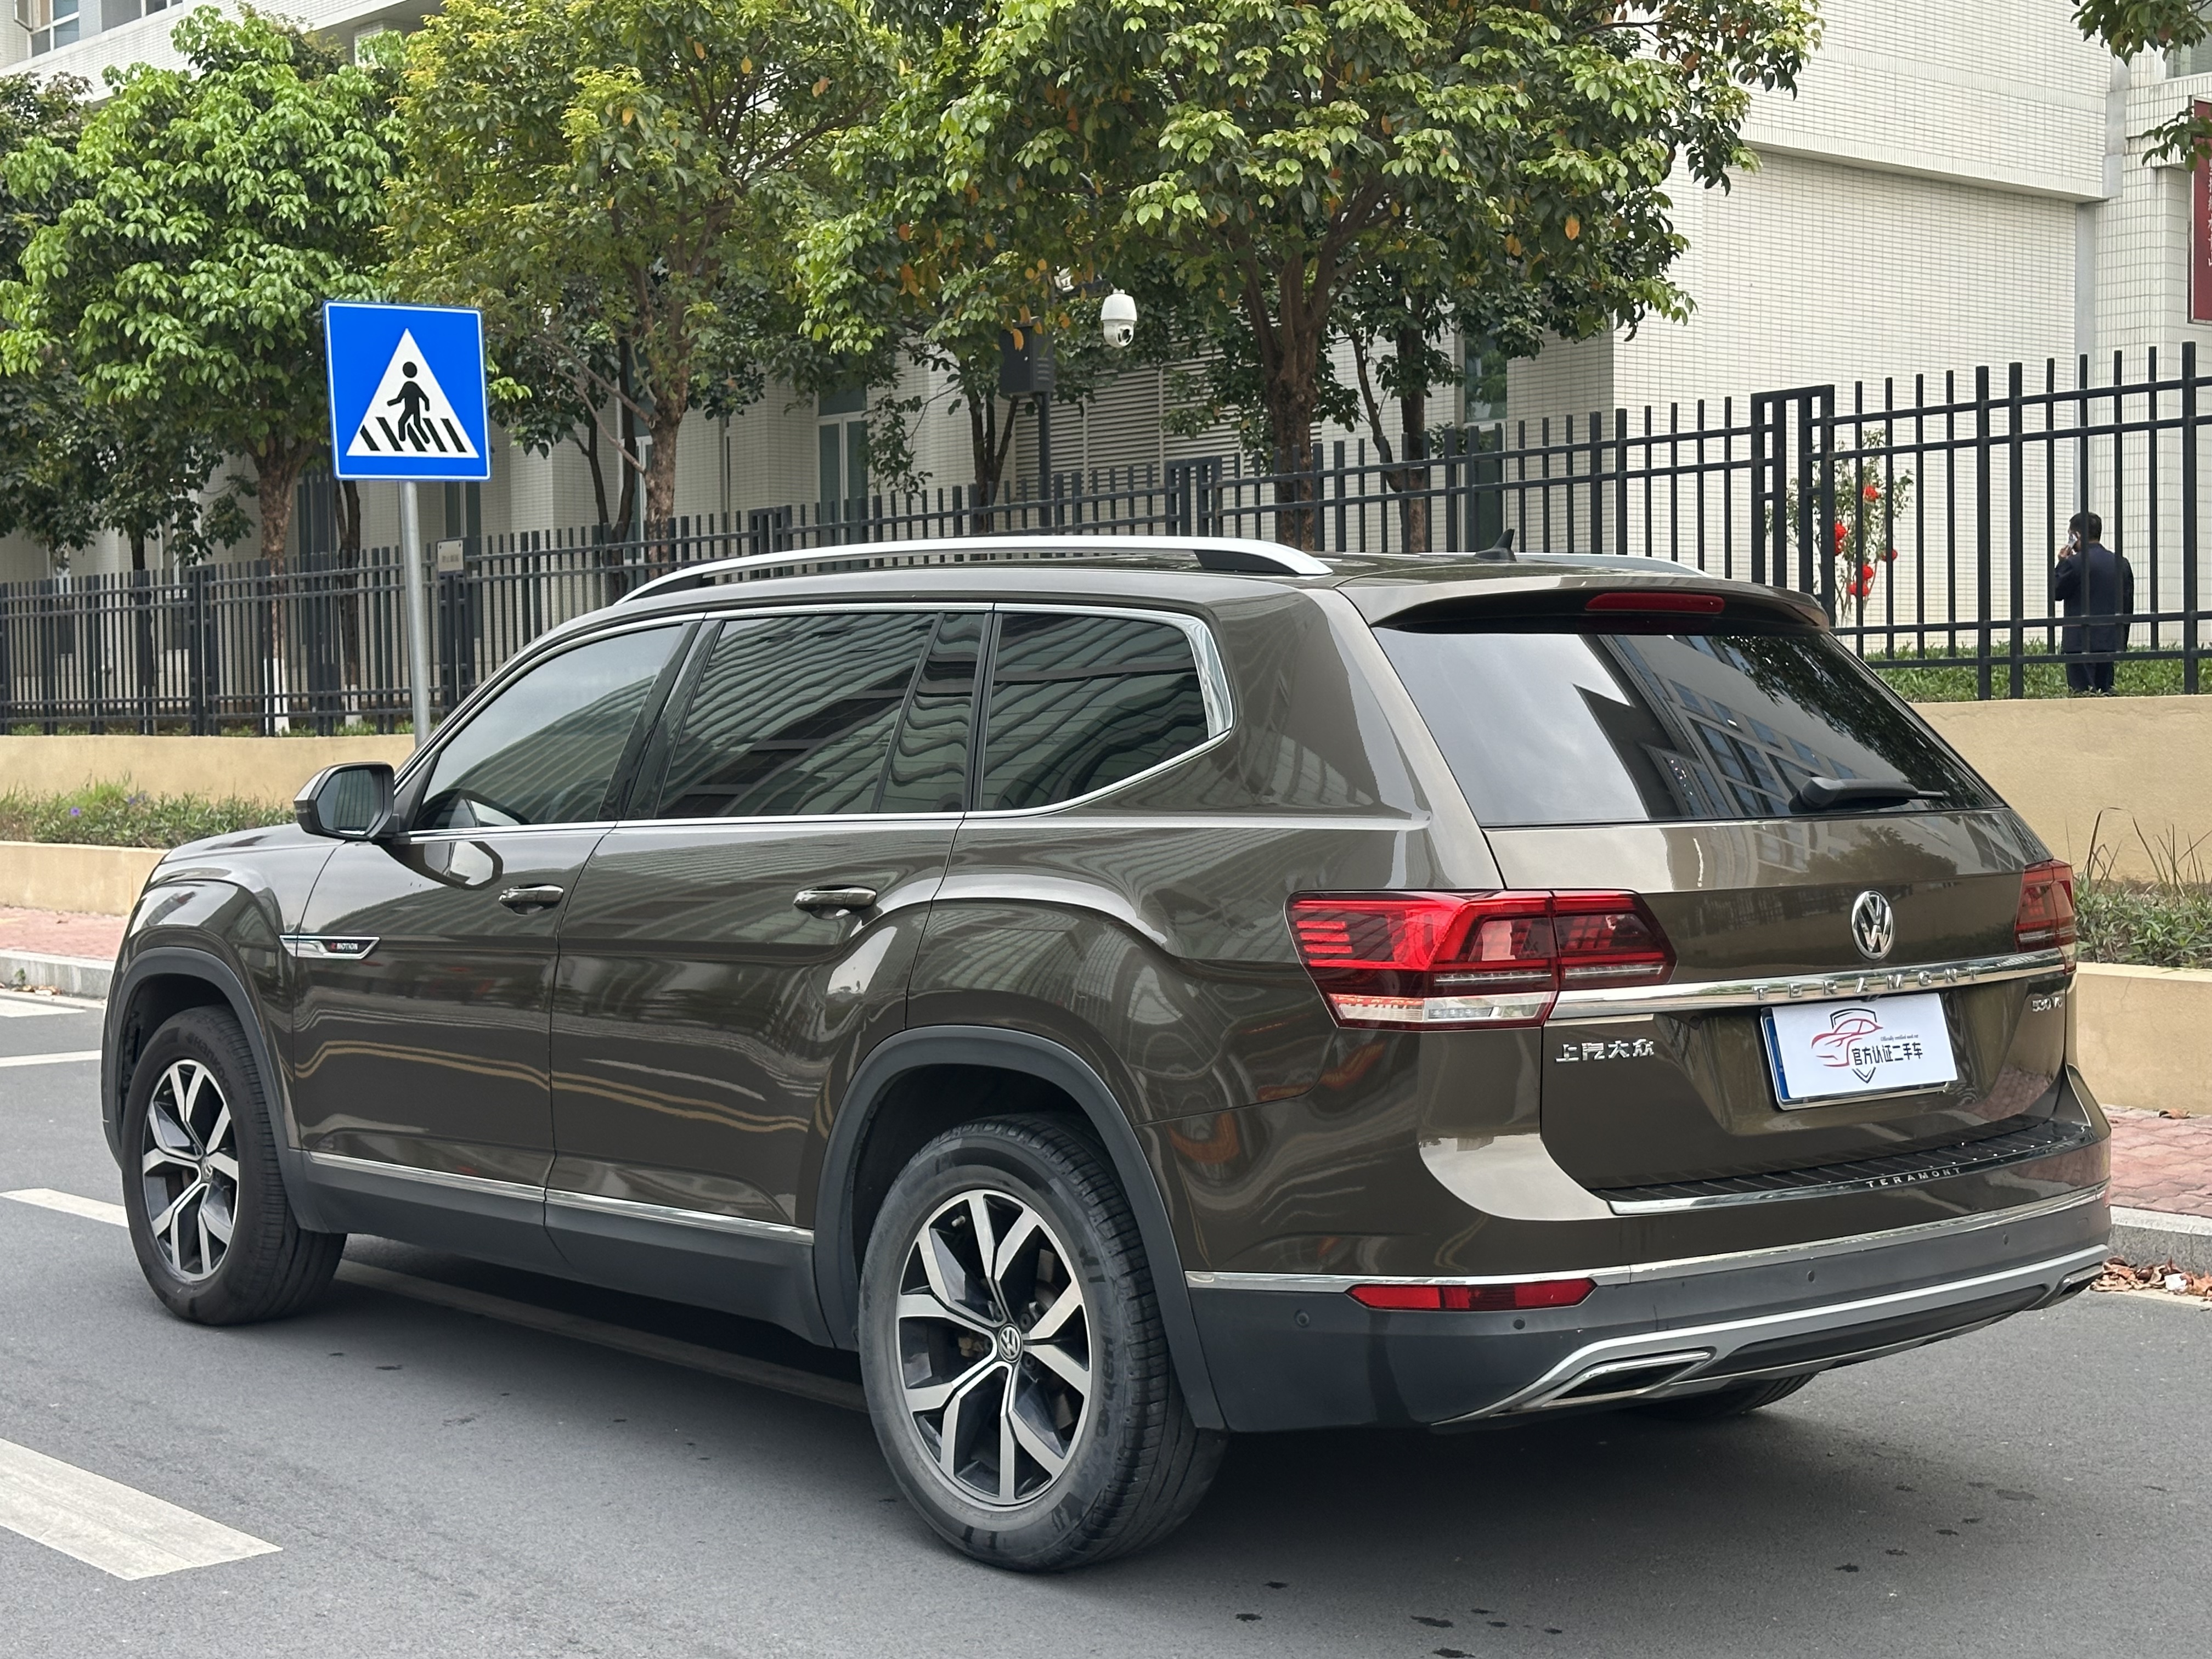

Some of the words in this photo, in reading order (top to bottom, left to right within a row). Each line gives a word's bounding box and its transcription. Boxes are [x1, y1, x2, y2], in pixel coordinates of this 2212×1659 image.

[1752, 967, 1979, 1001] TERAMONT
[1852, 1042, 1923, 1065] 官方认证二手车
[1866, 1167, 1961, 1188] TERAMONT
